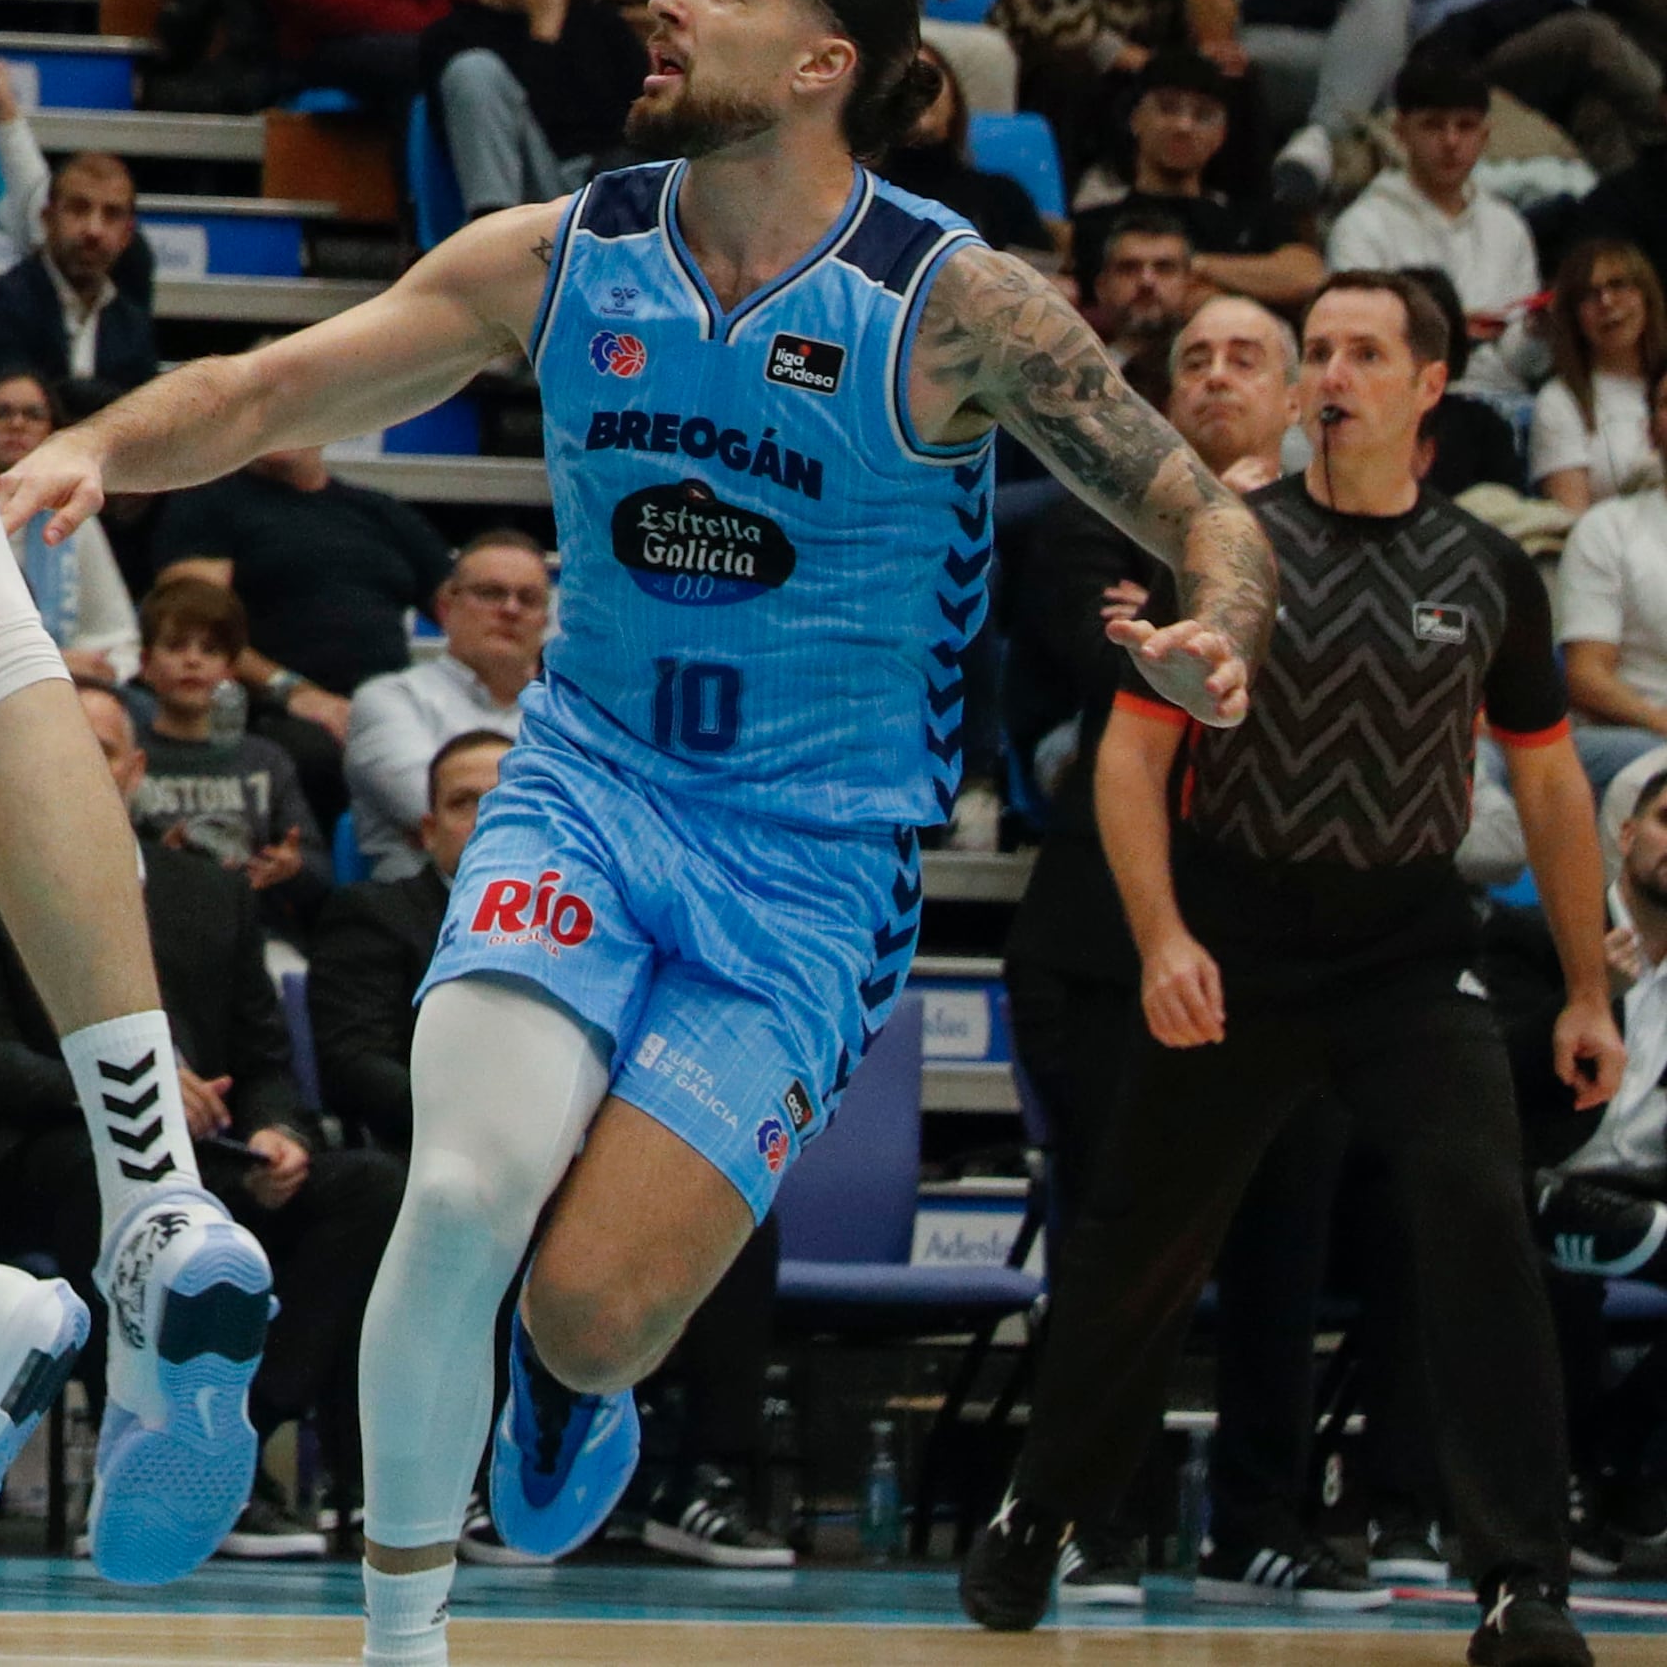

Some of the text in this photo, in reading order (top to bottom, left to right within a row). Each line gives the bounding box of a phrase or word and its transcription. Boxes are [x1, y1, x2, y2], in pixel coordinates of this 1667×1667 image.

[772, 363, 835, 389] endesa
[775, 347, 806, 367] liga
[586, 411, 824, 501] BREOGÁN
[637, 502, 762, 545] Estrella
[643, 532, 755, 578] Galicia
[652, 656, 744, 753] 10
[665, 1048, 714, 1089] XUNTA
[655, 1060, 740, 1130] DE GALICIA
